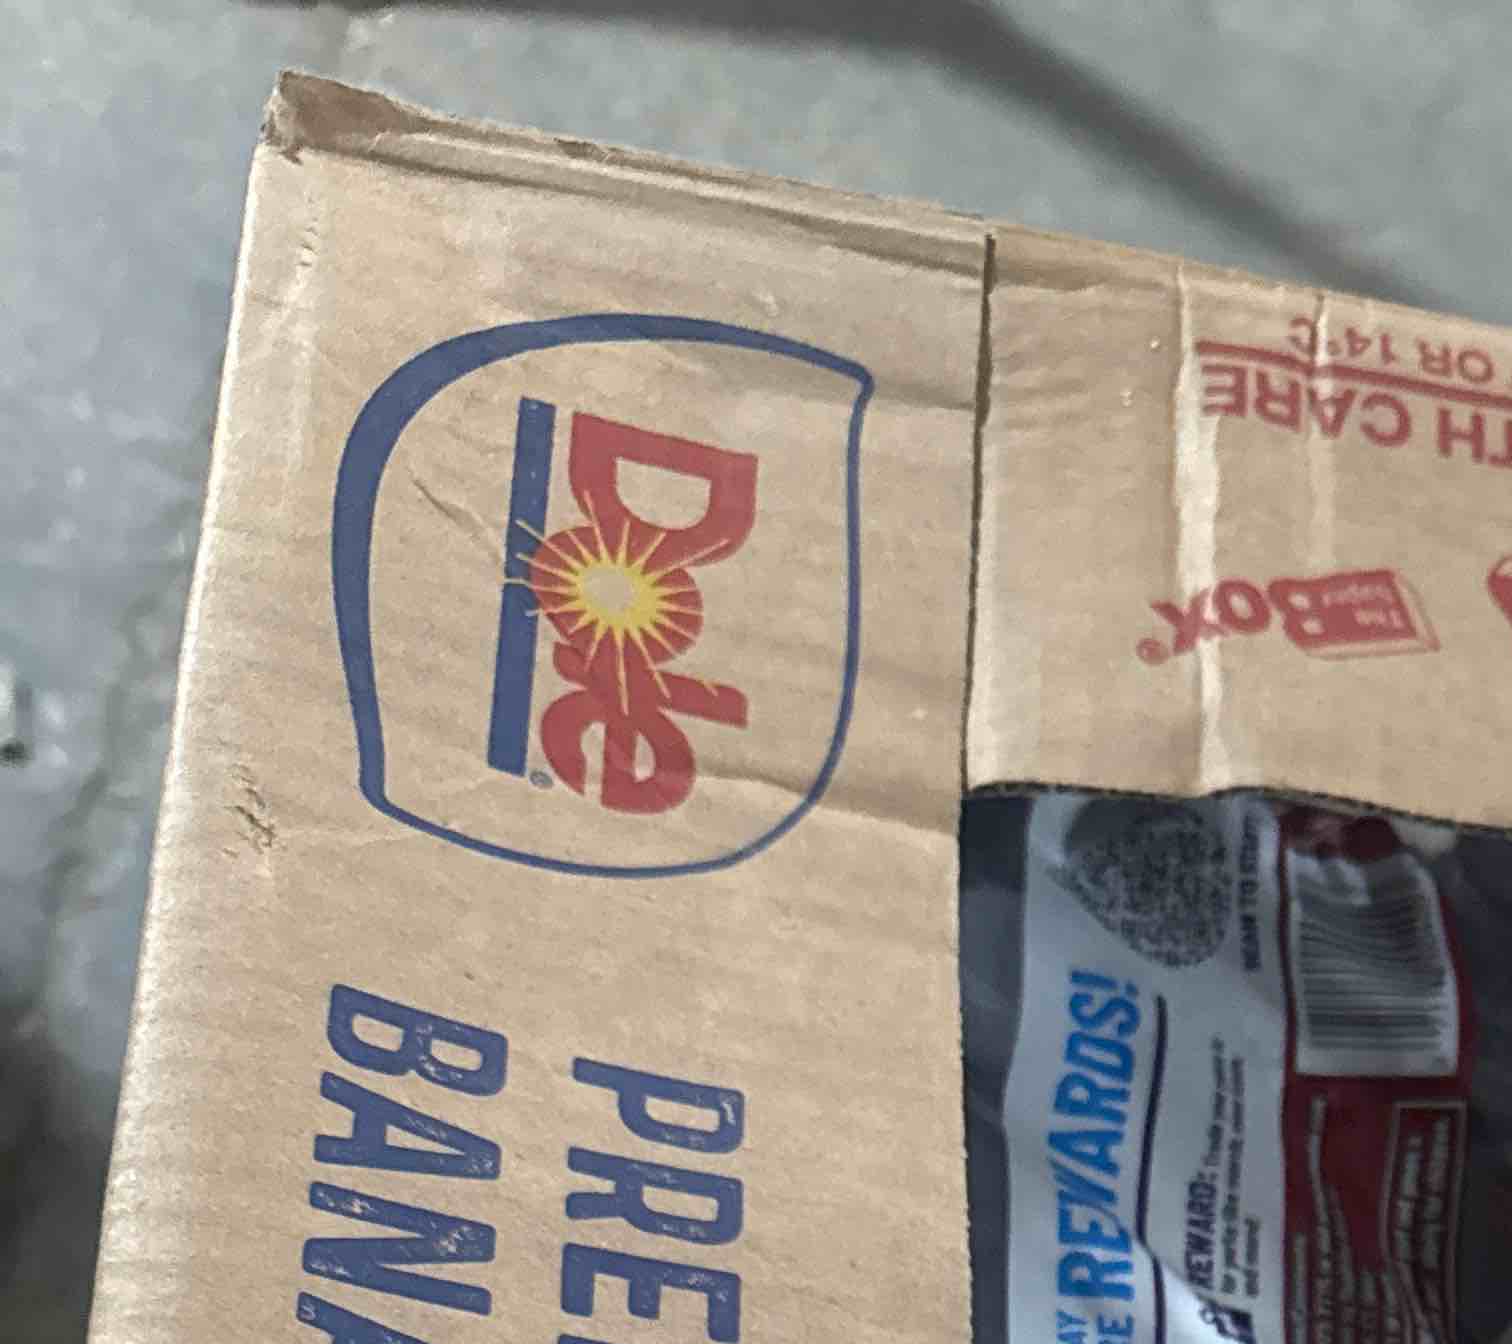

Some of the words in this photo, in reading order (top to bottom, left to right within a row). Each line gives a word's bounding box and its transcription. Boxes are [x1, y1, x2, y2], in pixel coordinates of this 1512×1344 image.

[1201, 362, 1412, 448] CARE
[1416, 339, 1494, 385] OR
[540, 412, 760, 815] Dole
